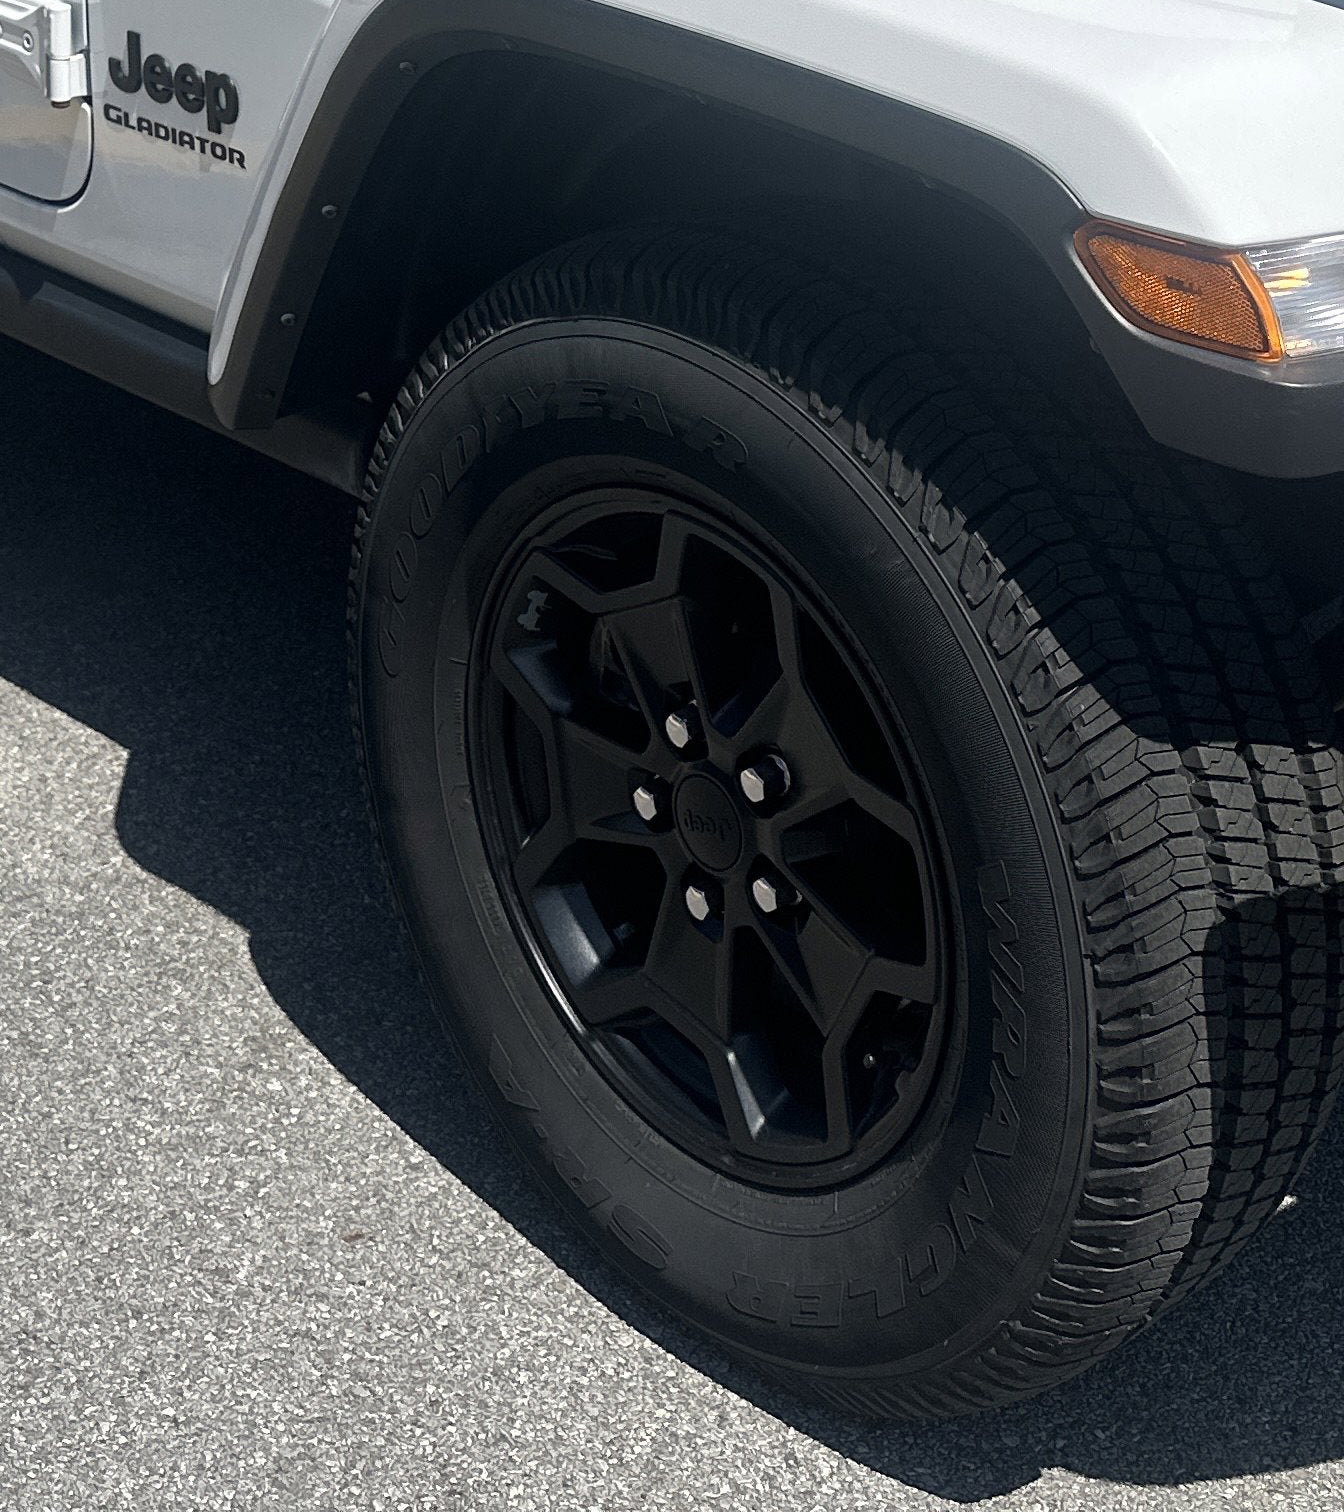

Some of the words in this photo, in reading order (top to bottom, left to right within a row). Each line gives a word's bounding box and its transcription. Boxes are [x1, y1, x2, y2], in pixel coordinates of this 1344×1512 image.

[103, 103, 247, 170] GLADIATOR
[108, 29, 240, 135] Jeep
[377, 377, 750, 678] GOODYEAR
[724, 861, 1029, 1328] WRANGLER
